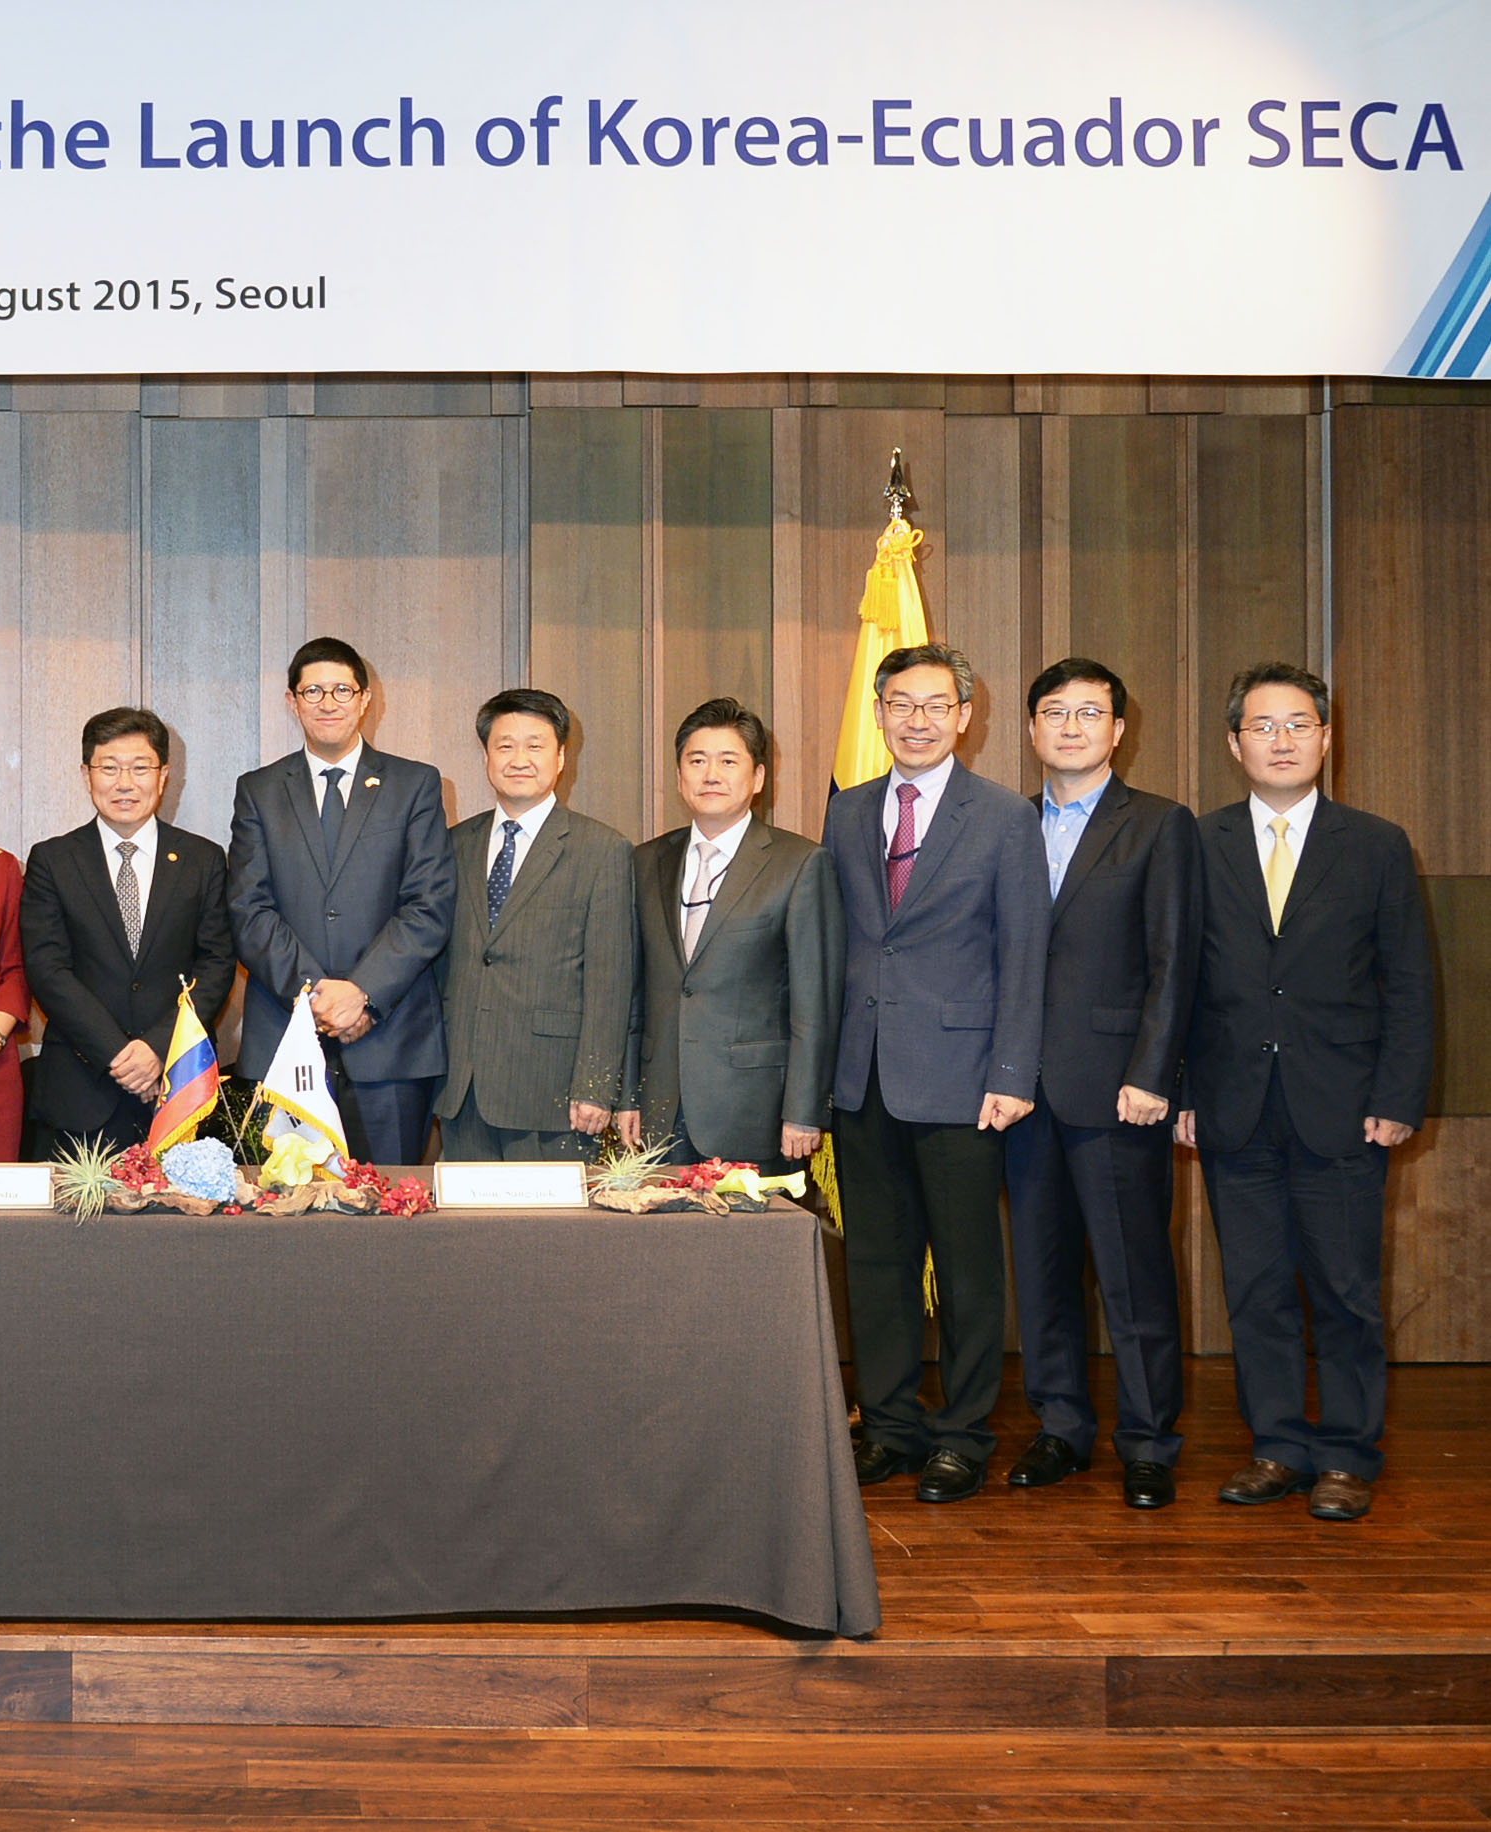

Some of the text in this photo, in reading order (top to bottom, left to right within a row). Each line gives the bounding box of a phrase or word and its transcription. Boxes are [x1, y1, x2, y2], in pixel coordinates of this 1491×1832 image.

[140, 96, 445, 169] Launch
[475, 95, 563, 167] of
[588, 97, 1220, 168] Korea-Ecuador
[1247, 100, 1464, 172] SECA
[93, 279, 202, 315] 2015,
[215, 276, 327, 310] Seoul
